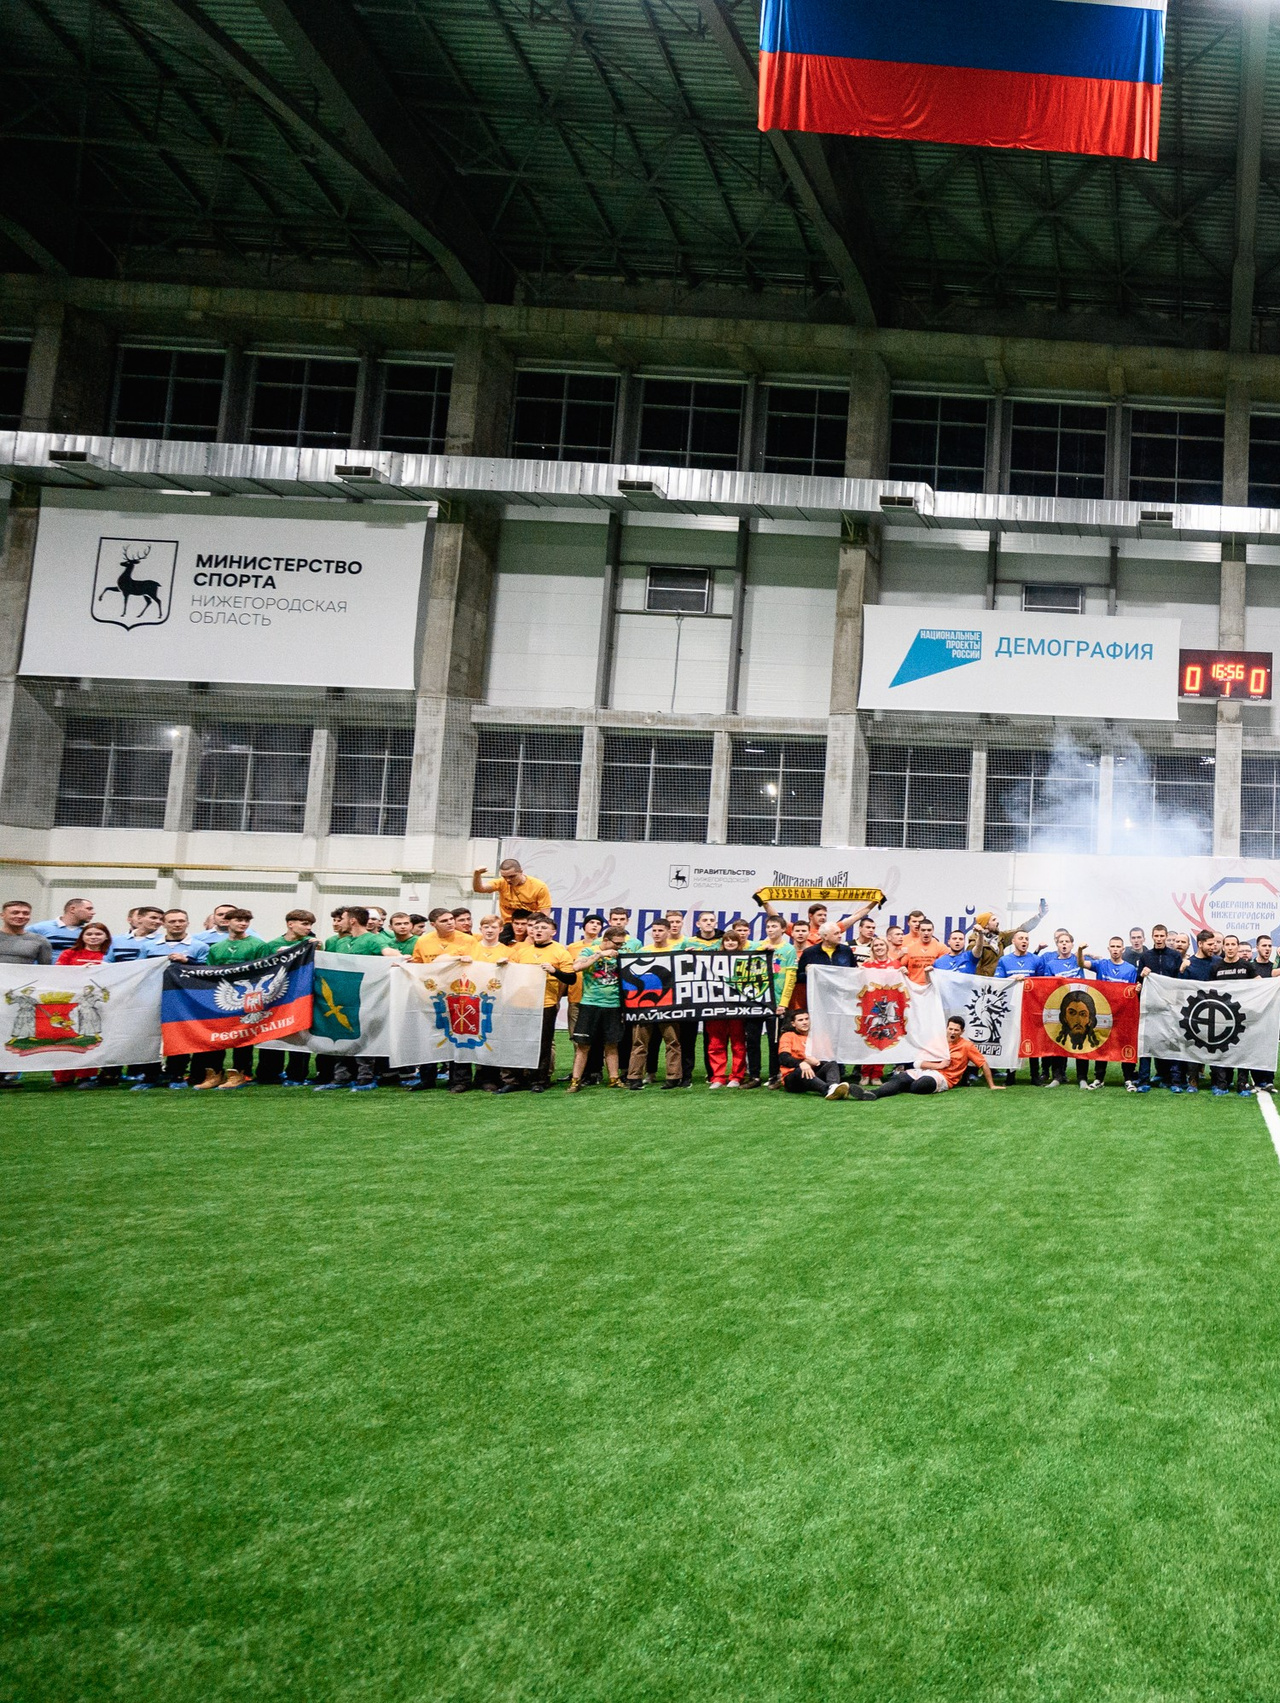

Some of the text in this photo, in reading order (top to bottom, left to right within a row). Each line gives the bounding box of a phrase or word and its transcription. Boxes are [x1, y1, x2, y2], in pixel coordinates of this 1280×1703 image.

[195, 553, 363, 575] МИНИСТЕРСТВО
[193, 572, 277, 590] СПОРТА
[191, 594, 348, 613] НИЖЕГОРОДСКАЯ
[189, 610, 272, 627] ОБЛАСТЬ
[920, 630, 981, 641] НАЦИОНАЛЬНЫЕ
[945, 640, 981, 649] ПРОЕКТЫ
[995, 637, 1154, 660] ДЕМОГРАФИЯ
[951, 649, 981, 659] РОССИИ
[1185, 666, 1201, 691] 0
[1211, 664, 1245, 680] 16:56
[1250, 669, 1266, 693] 0
[693, 868, 756, 876] ПРАВИТЕЛЬСТВО
[1208, 900, 1278, 910] ФЕДЕРАЦИЯ КИЛЫ
[1211, 910, 1275, 920] НИЖЕГОРОДСКОЙ
[1226, 921, 1260, 930] ОБЛАСТИ
[625, 1006, 774, 1022] МАЙКОП ДРУЖБА
[974, 1029, 984, 1038] 34
